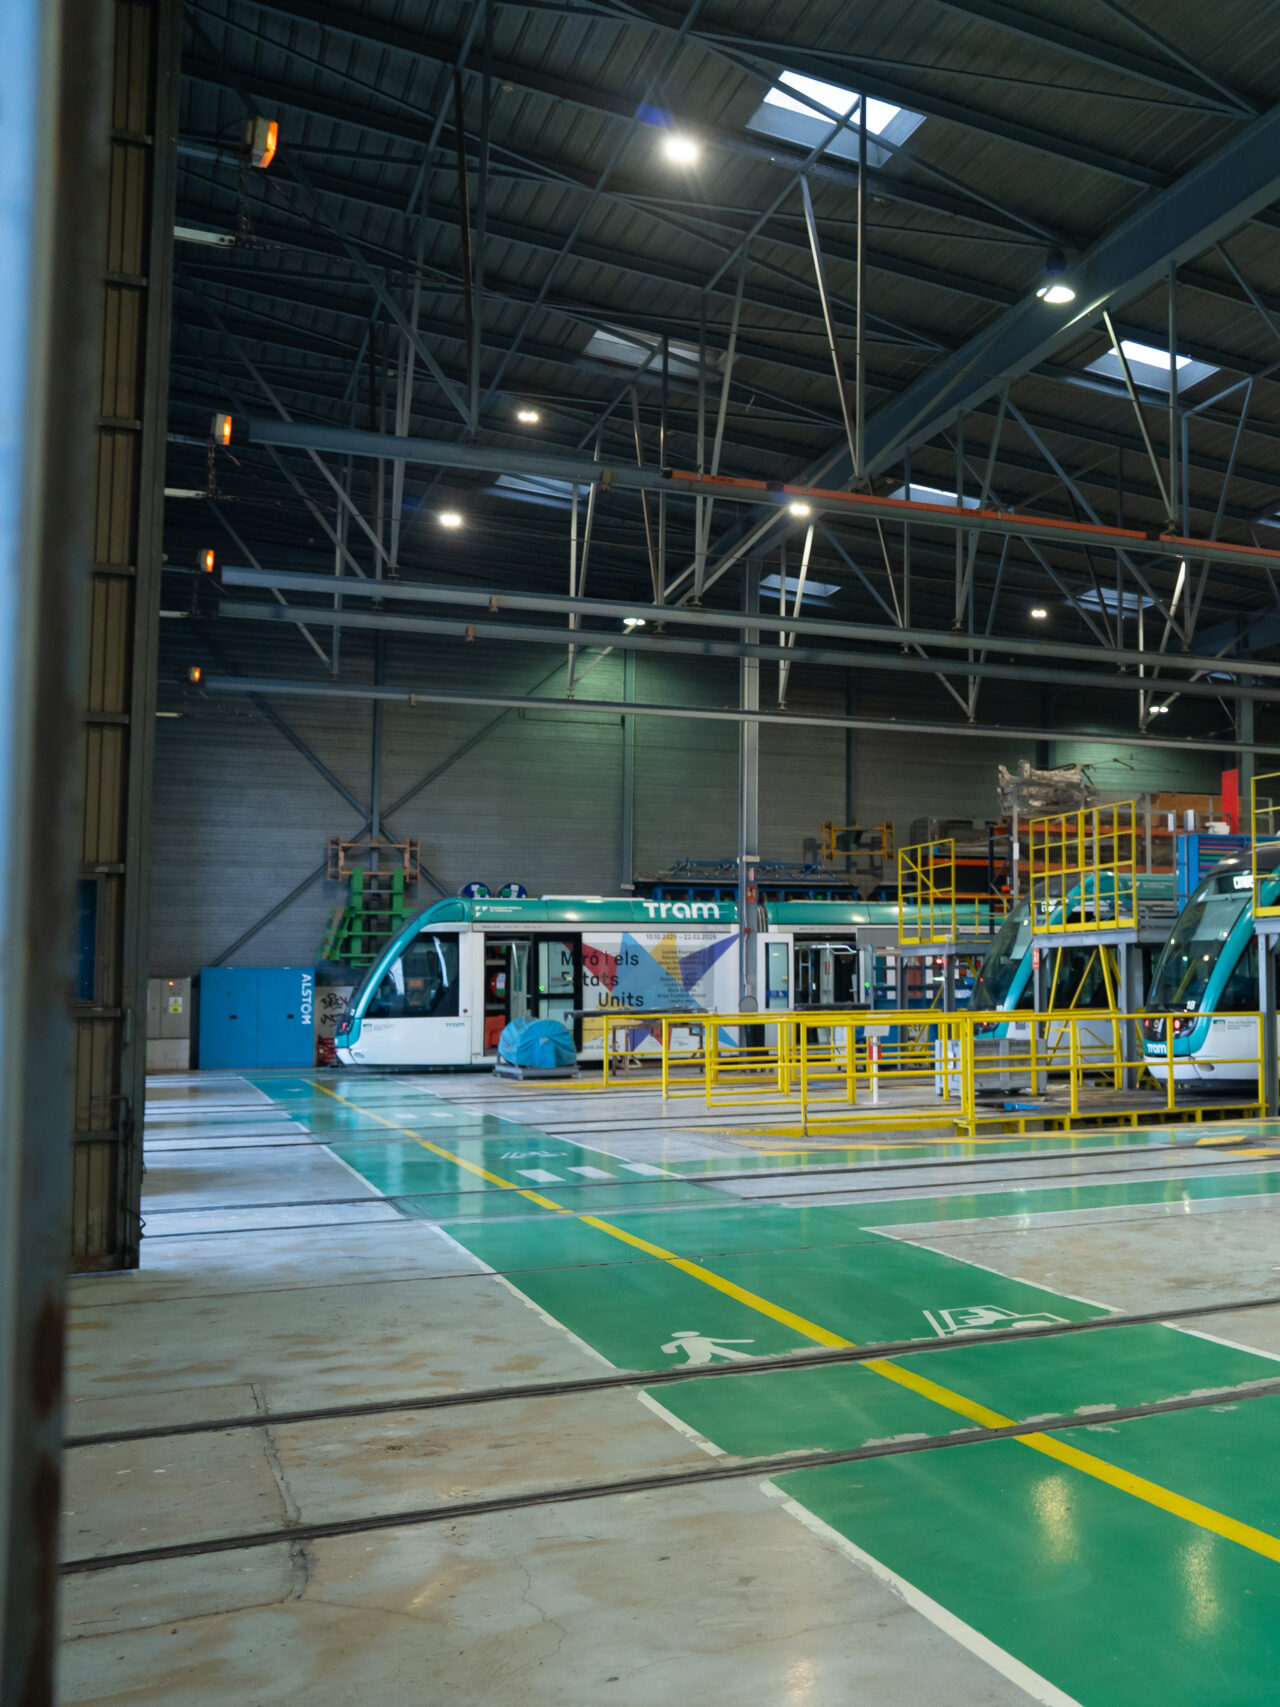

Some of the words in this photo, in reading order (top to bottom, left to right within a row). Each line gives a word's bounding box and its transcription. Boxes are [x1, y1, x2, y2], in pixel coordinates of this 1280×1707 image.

[614, 951, 640, 967] els
[301, 973, 313, 1025] ALSTOM
[598, 991, 645, 1008] Units
